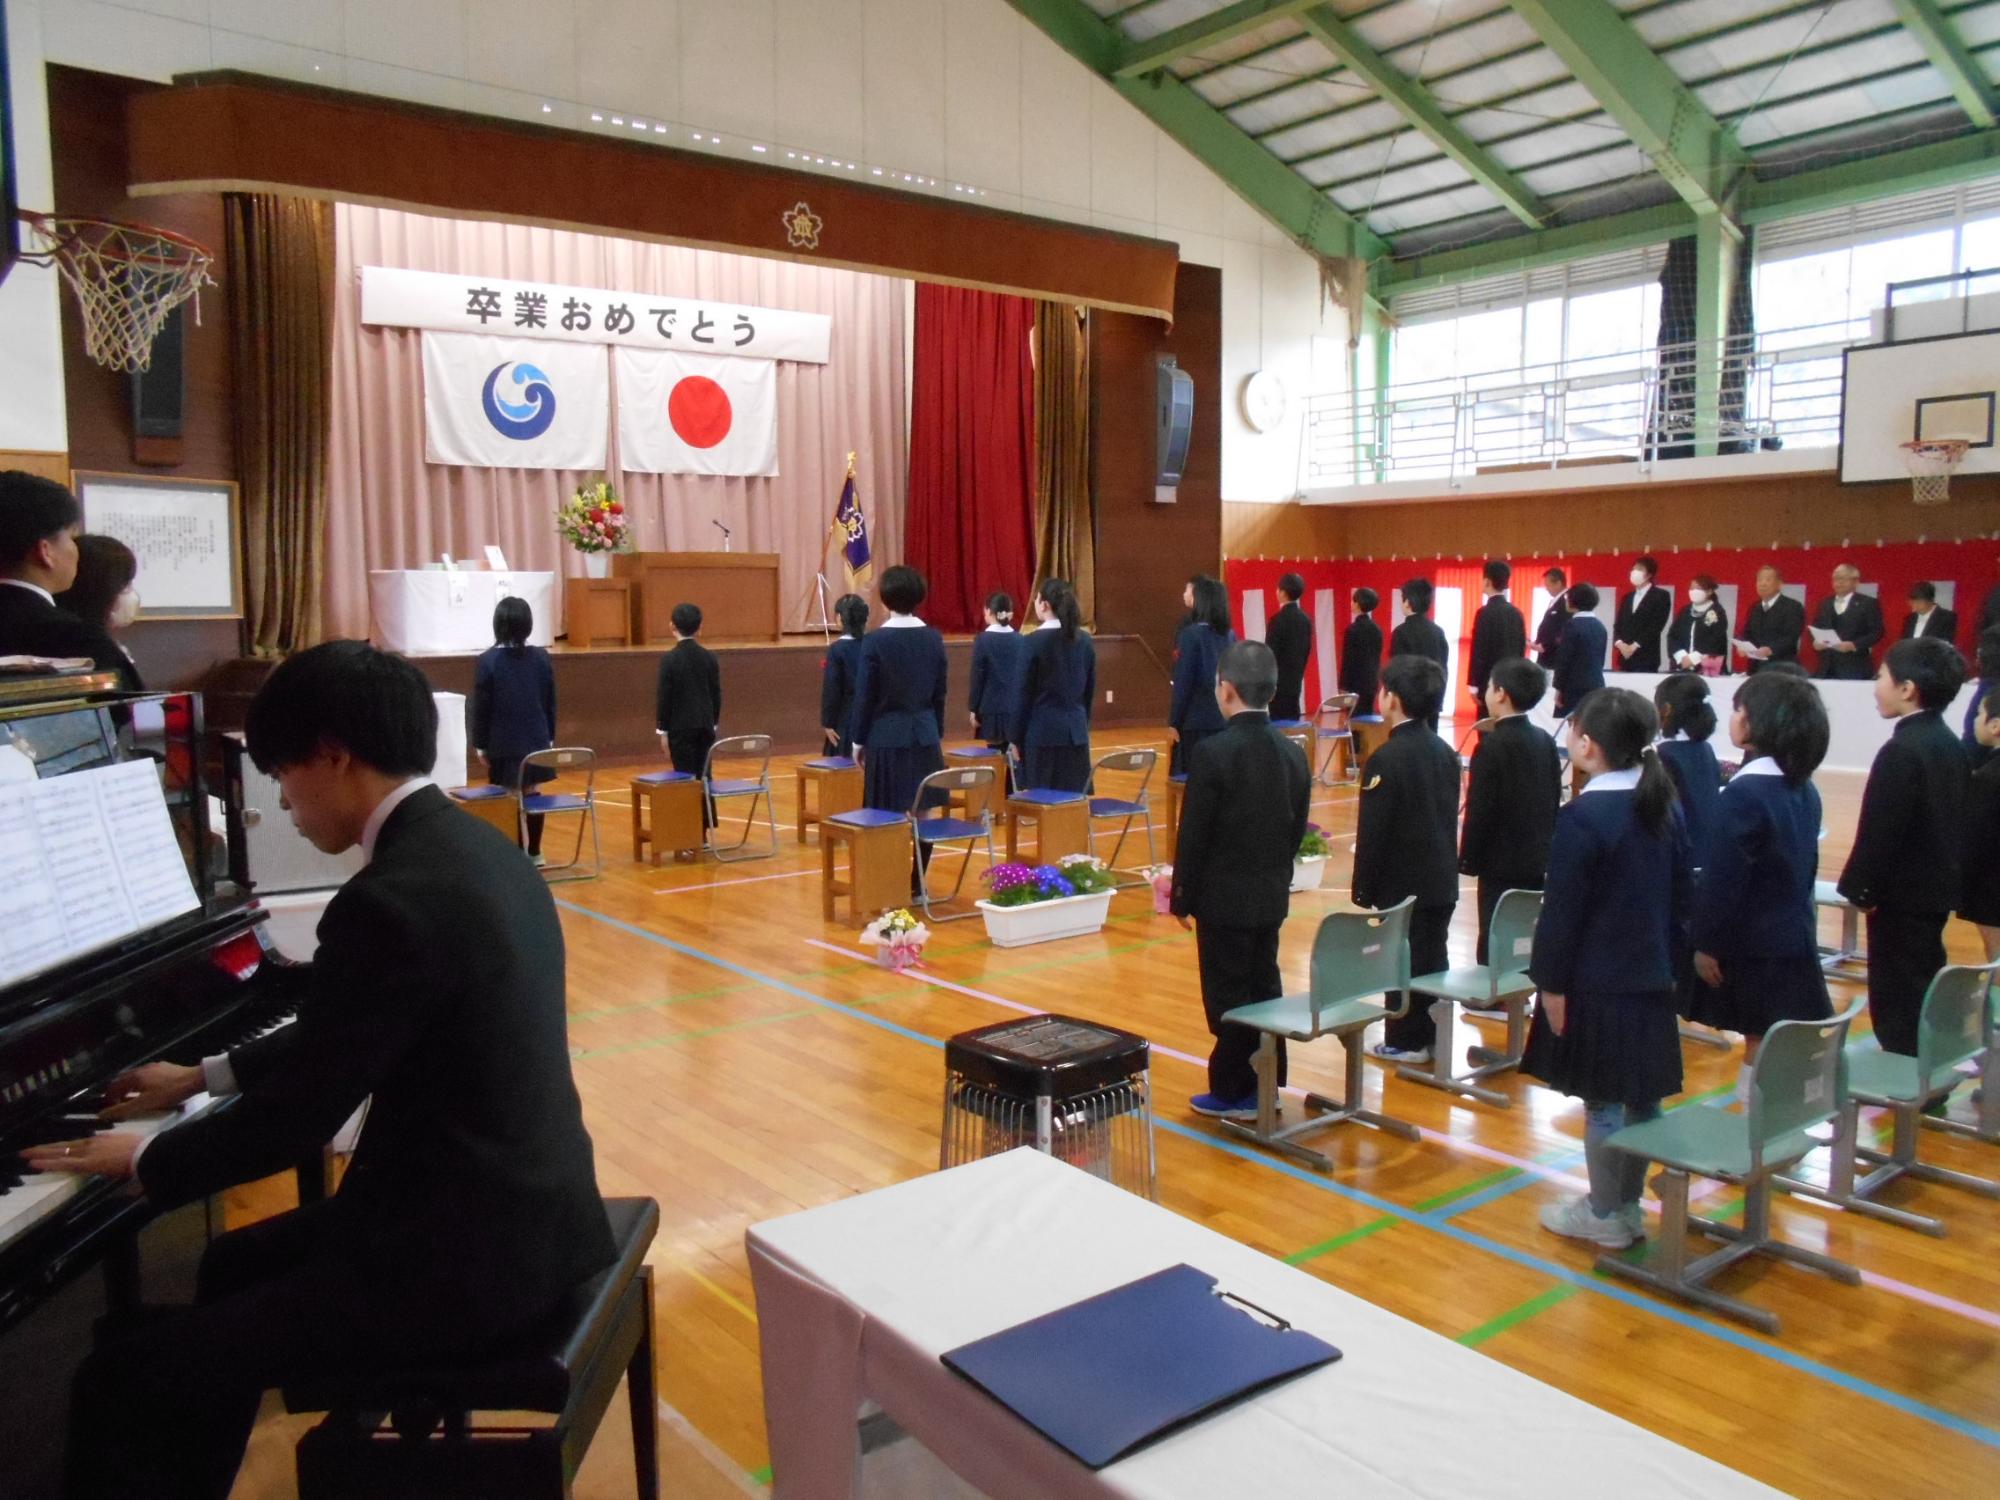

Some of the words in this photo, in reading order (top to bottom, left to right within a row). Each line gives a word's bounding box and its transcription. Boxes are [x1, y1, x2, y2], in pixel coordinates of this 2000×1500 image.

[466, 286, 756, 347] 卒業おめでとう
